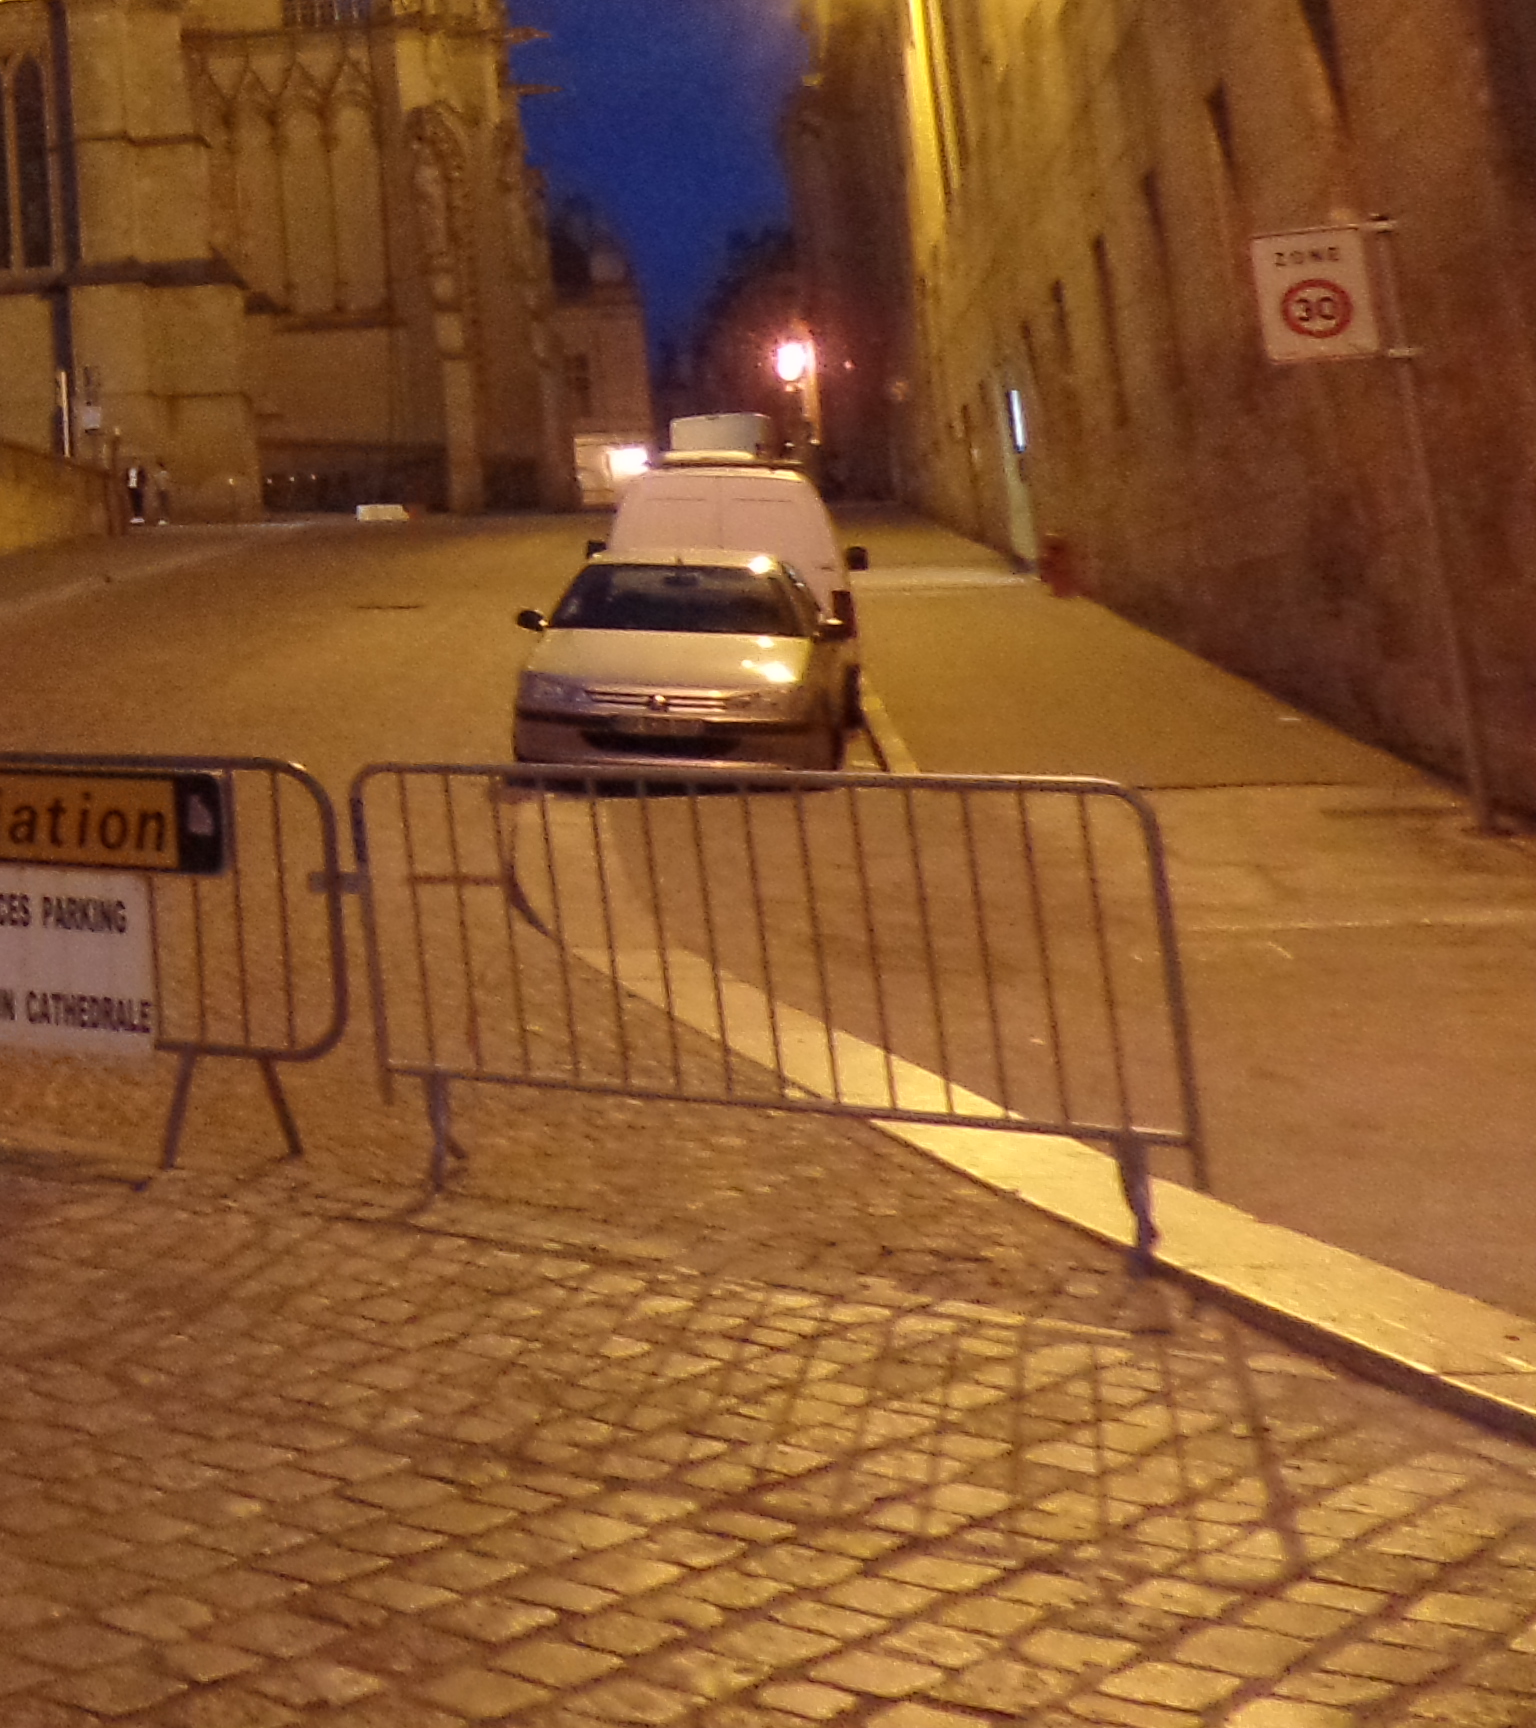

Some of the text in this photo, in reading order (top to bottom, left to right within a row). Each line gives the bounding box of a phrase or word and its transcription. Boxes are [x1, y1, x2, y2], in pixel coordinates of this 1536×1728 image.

[1296, 295, 1337, 322] 30
[42, 895, 127, 934] PARKING
[26, 989, 152, 1034] CATHEDRALE
